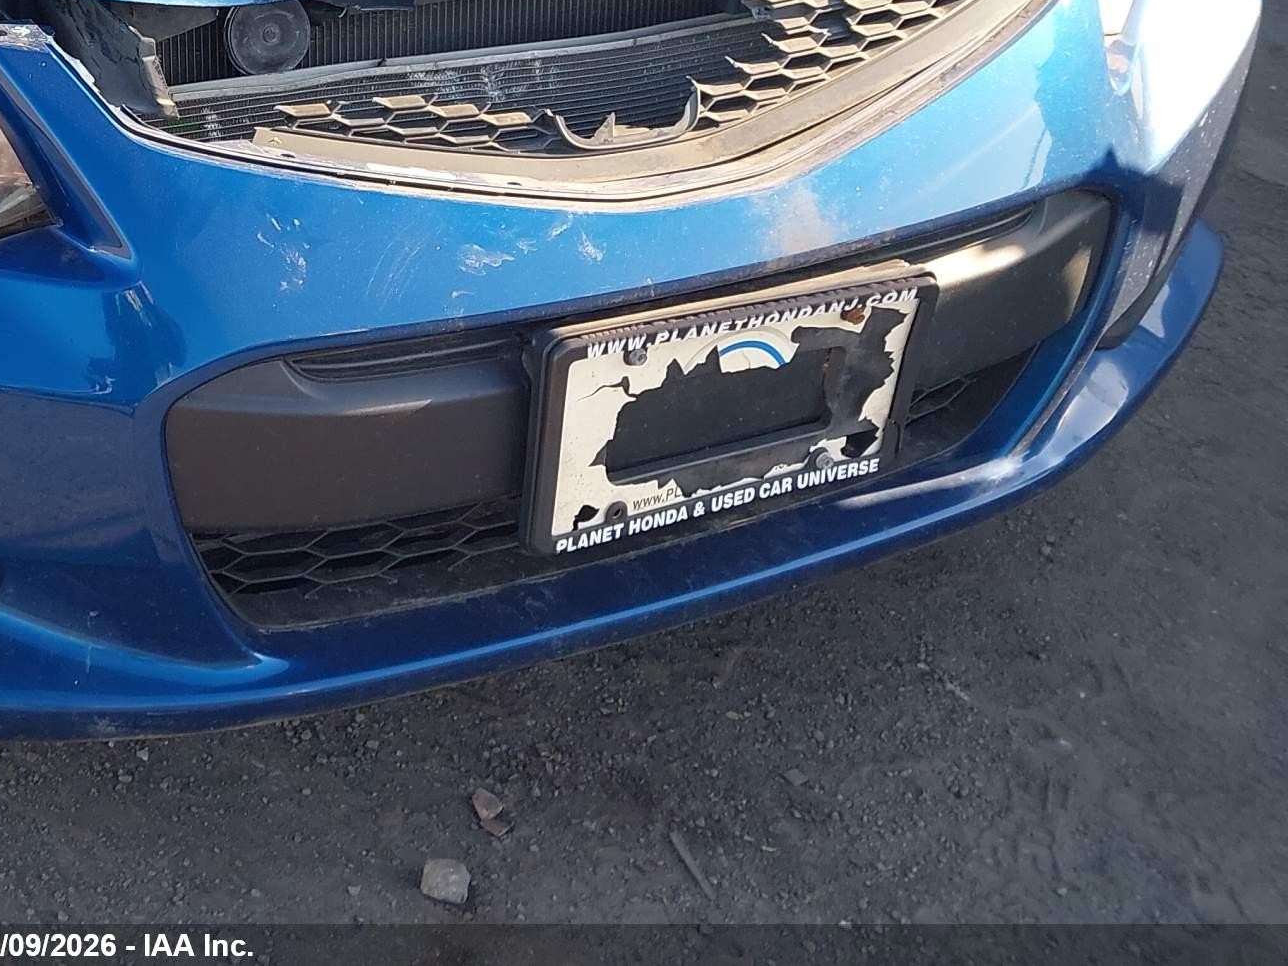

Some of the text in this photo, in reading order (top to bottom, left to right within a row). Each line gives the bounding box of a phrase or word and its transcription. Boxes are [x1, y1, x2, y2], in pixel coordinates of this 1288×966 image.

[587, 287, 919, 359] WWW.PLANETHONDANJ.COM
[556, 458, 880, 554] PLANET HONDA & USED CAR UNIVERSE
